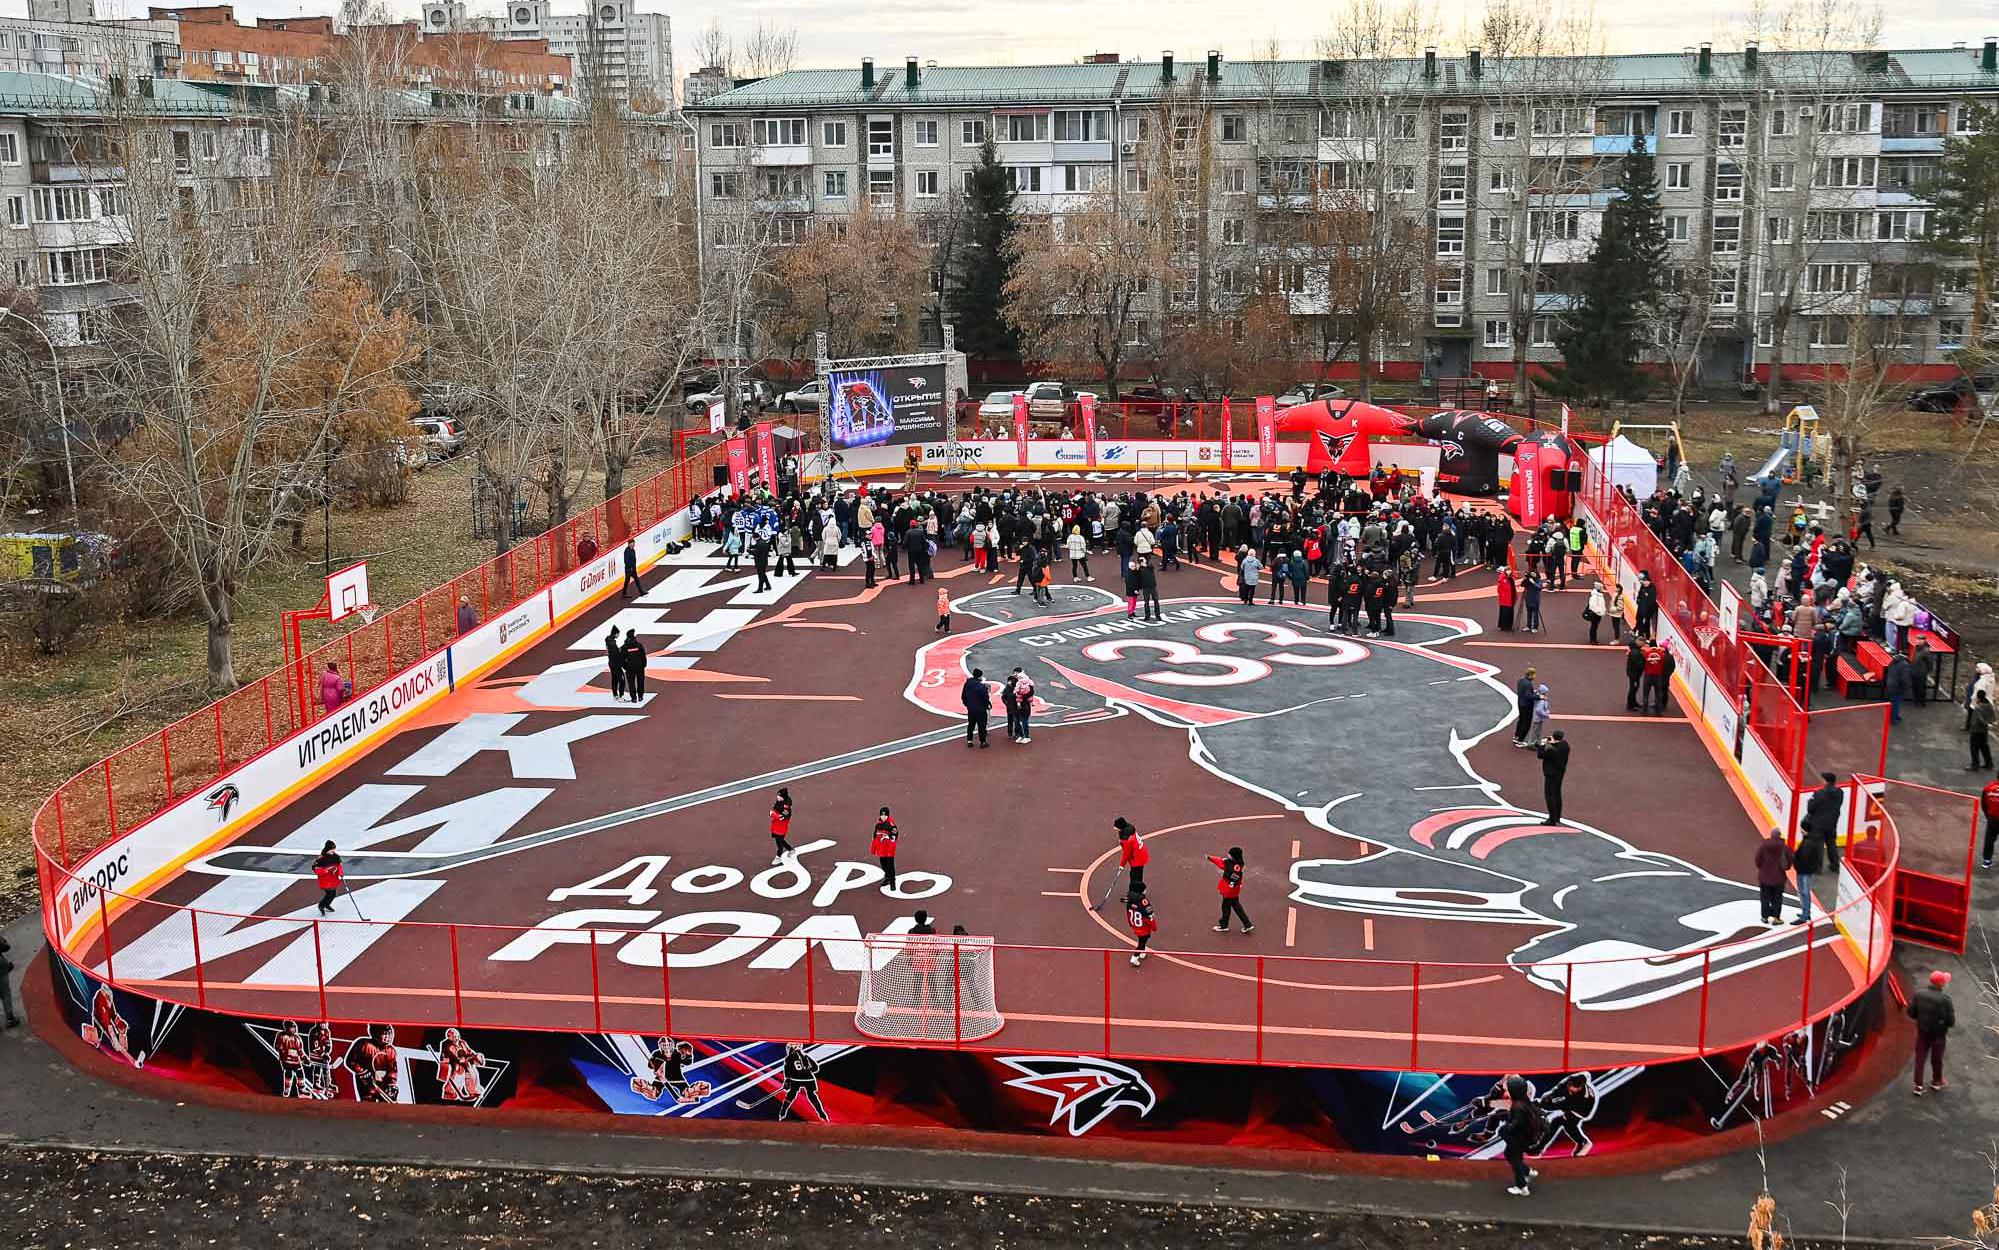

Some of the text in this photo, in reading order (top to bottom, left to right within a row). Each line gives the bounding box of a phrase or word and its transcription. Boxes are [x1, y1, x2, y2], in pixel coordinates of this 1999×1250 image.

[893, 392, 942, 402] ОТКРЫТИЕ
[894, 421, 942, 431] СУШИНСКОГО
[899, 415, 935, 424] МАКСИМА
[1066, 593, 1095, 602] 33
[1081, 622, 1371, 687] 33
[298, 665, 435, 769] ИГРАЕМ ЗА ОМСК
[547, 839, 953, 908] Добро
[488, 909, 935, 972] FON
